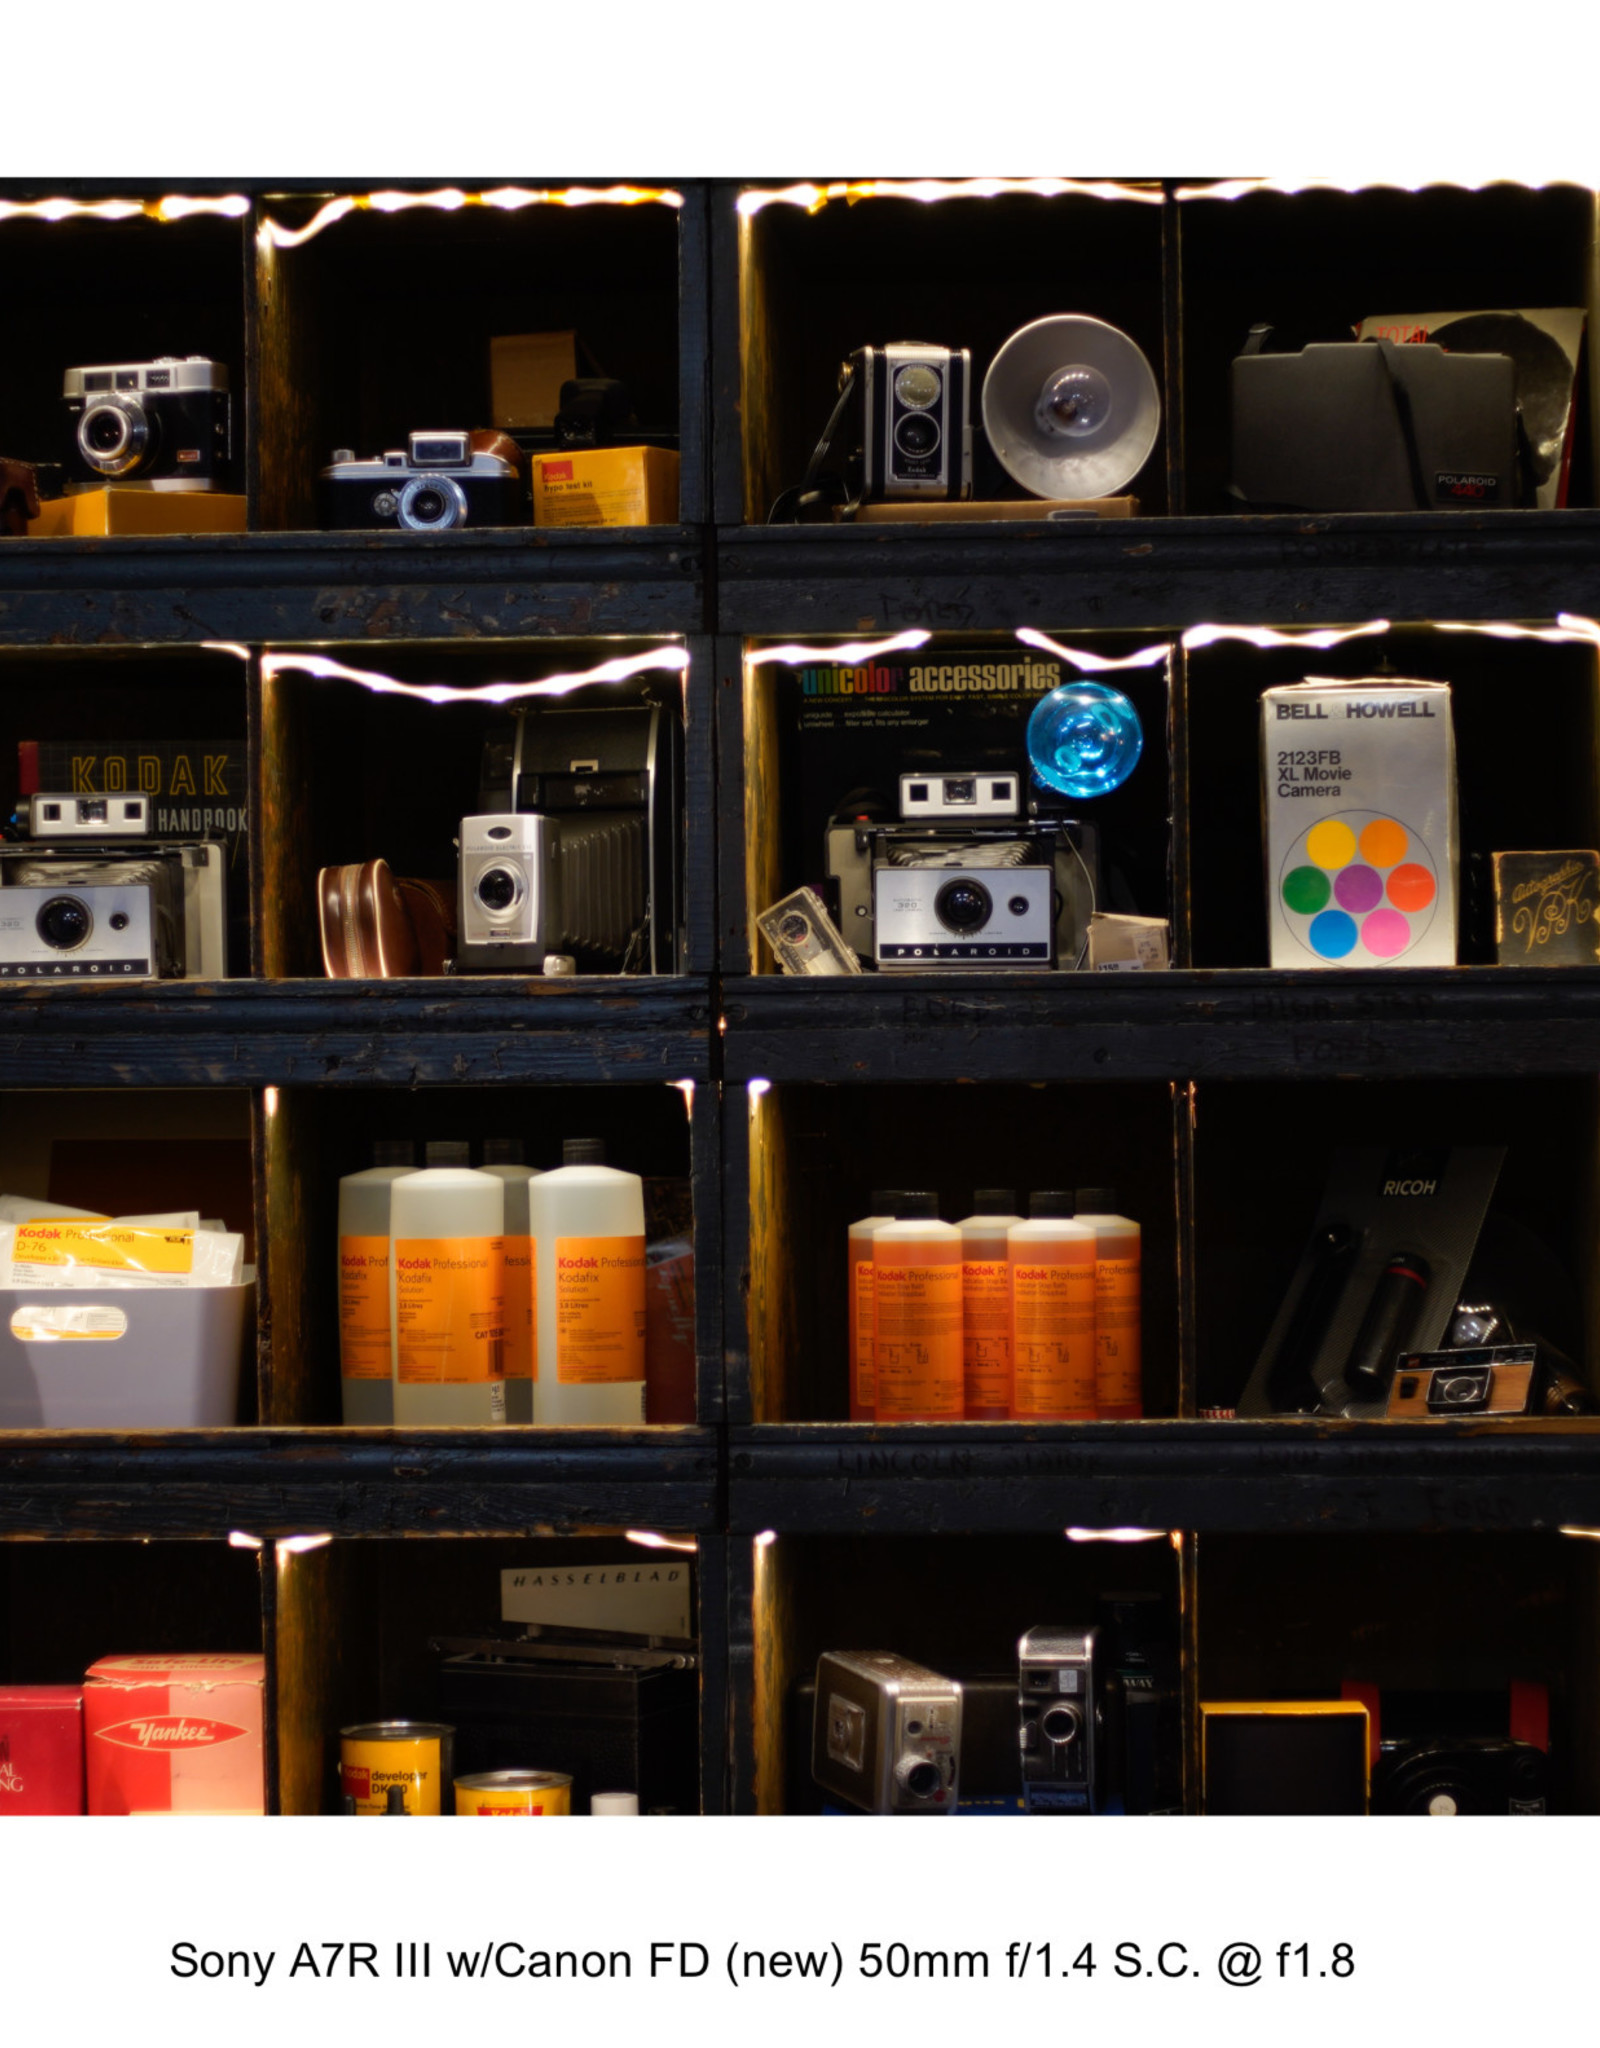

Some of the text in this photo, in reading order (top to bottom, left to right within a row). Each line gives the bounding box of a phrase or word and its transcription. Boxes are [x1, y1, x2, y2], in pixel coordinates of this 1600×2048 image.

[1438, 474, 1497, 487] POLAROID
[802, 656, 1061, 695] unicolor accessories
[1276, 702, 1436, 720] BELL HOWELL
[1277, 750, 1342, 766] 2123FB
[72, 755, 230, 797] KODAK
[1277, 766, 1352, 782] XL Movie
[1277, 783, 1342, 798] Camera
[158, 807, 249, 833] HANDBOOK
[897, 947, 1031, 956] POLAROID
[2, 963, 133, 975] POLAROID
[1383, 1179, 1438, 1196] RICOH
[18, 1228, 62, 1240] Kodak
[16, 1241, 48, 1253] D-76
[341, 1256, 367, 1268] Kodak
[398, 1258, 432, 1270] Kodak
[558, 1256, 599, 1269] Kodak
[877, 1272, 907, 1281] Kodak
[964, 1266, 995, 1276] Kodak
[1015, 1271, 1048, 1280] Kodak
[398, 1272, 432, 1284] Kodafix
[559, 1272, 600, 1283] Kodafix
[399, 1285, 424, 1293] Solution
[559, 1285, 589, 1294] Solution
[474, 1331, 489, 1339] CAT
[512, 1570, 681, 1588] HASSELBLAD
[130, 1718, 216, 1748] Yankee
[371, 1770, 429, 1783] developer
